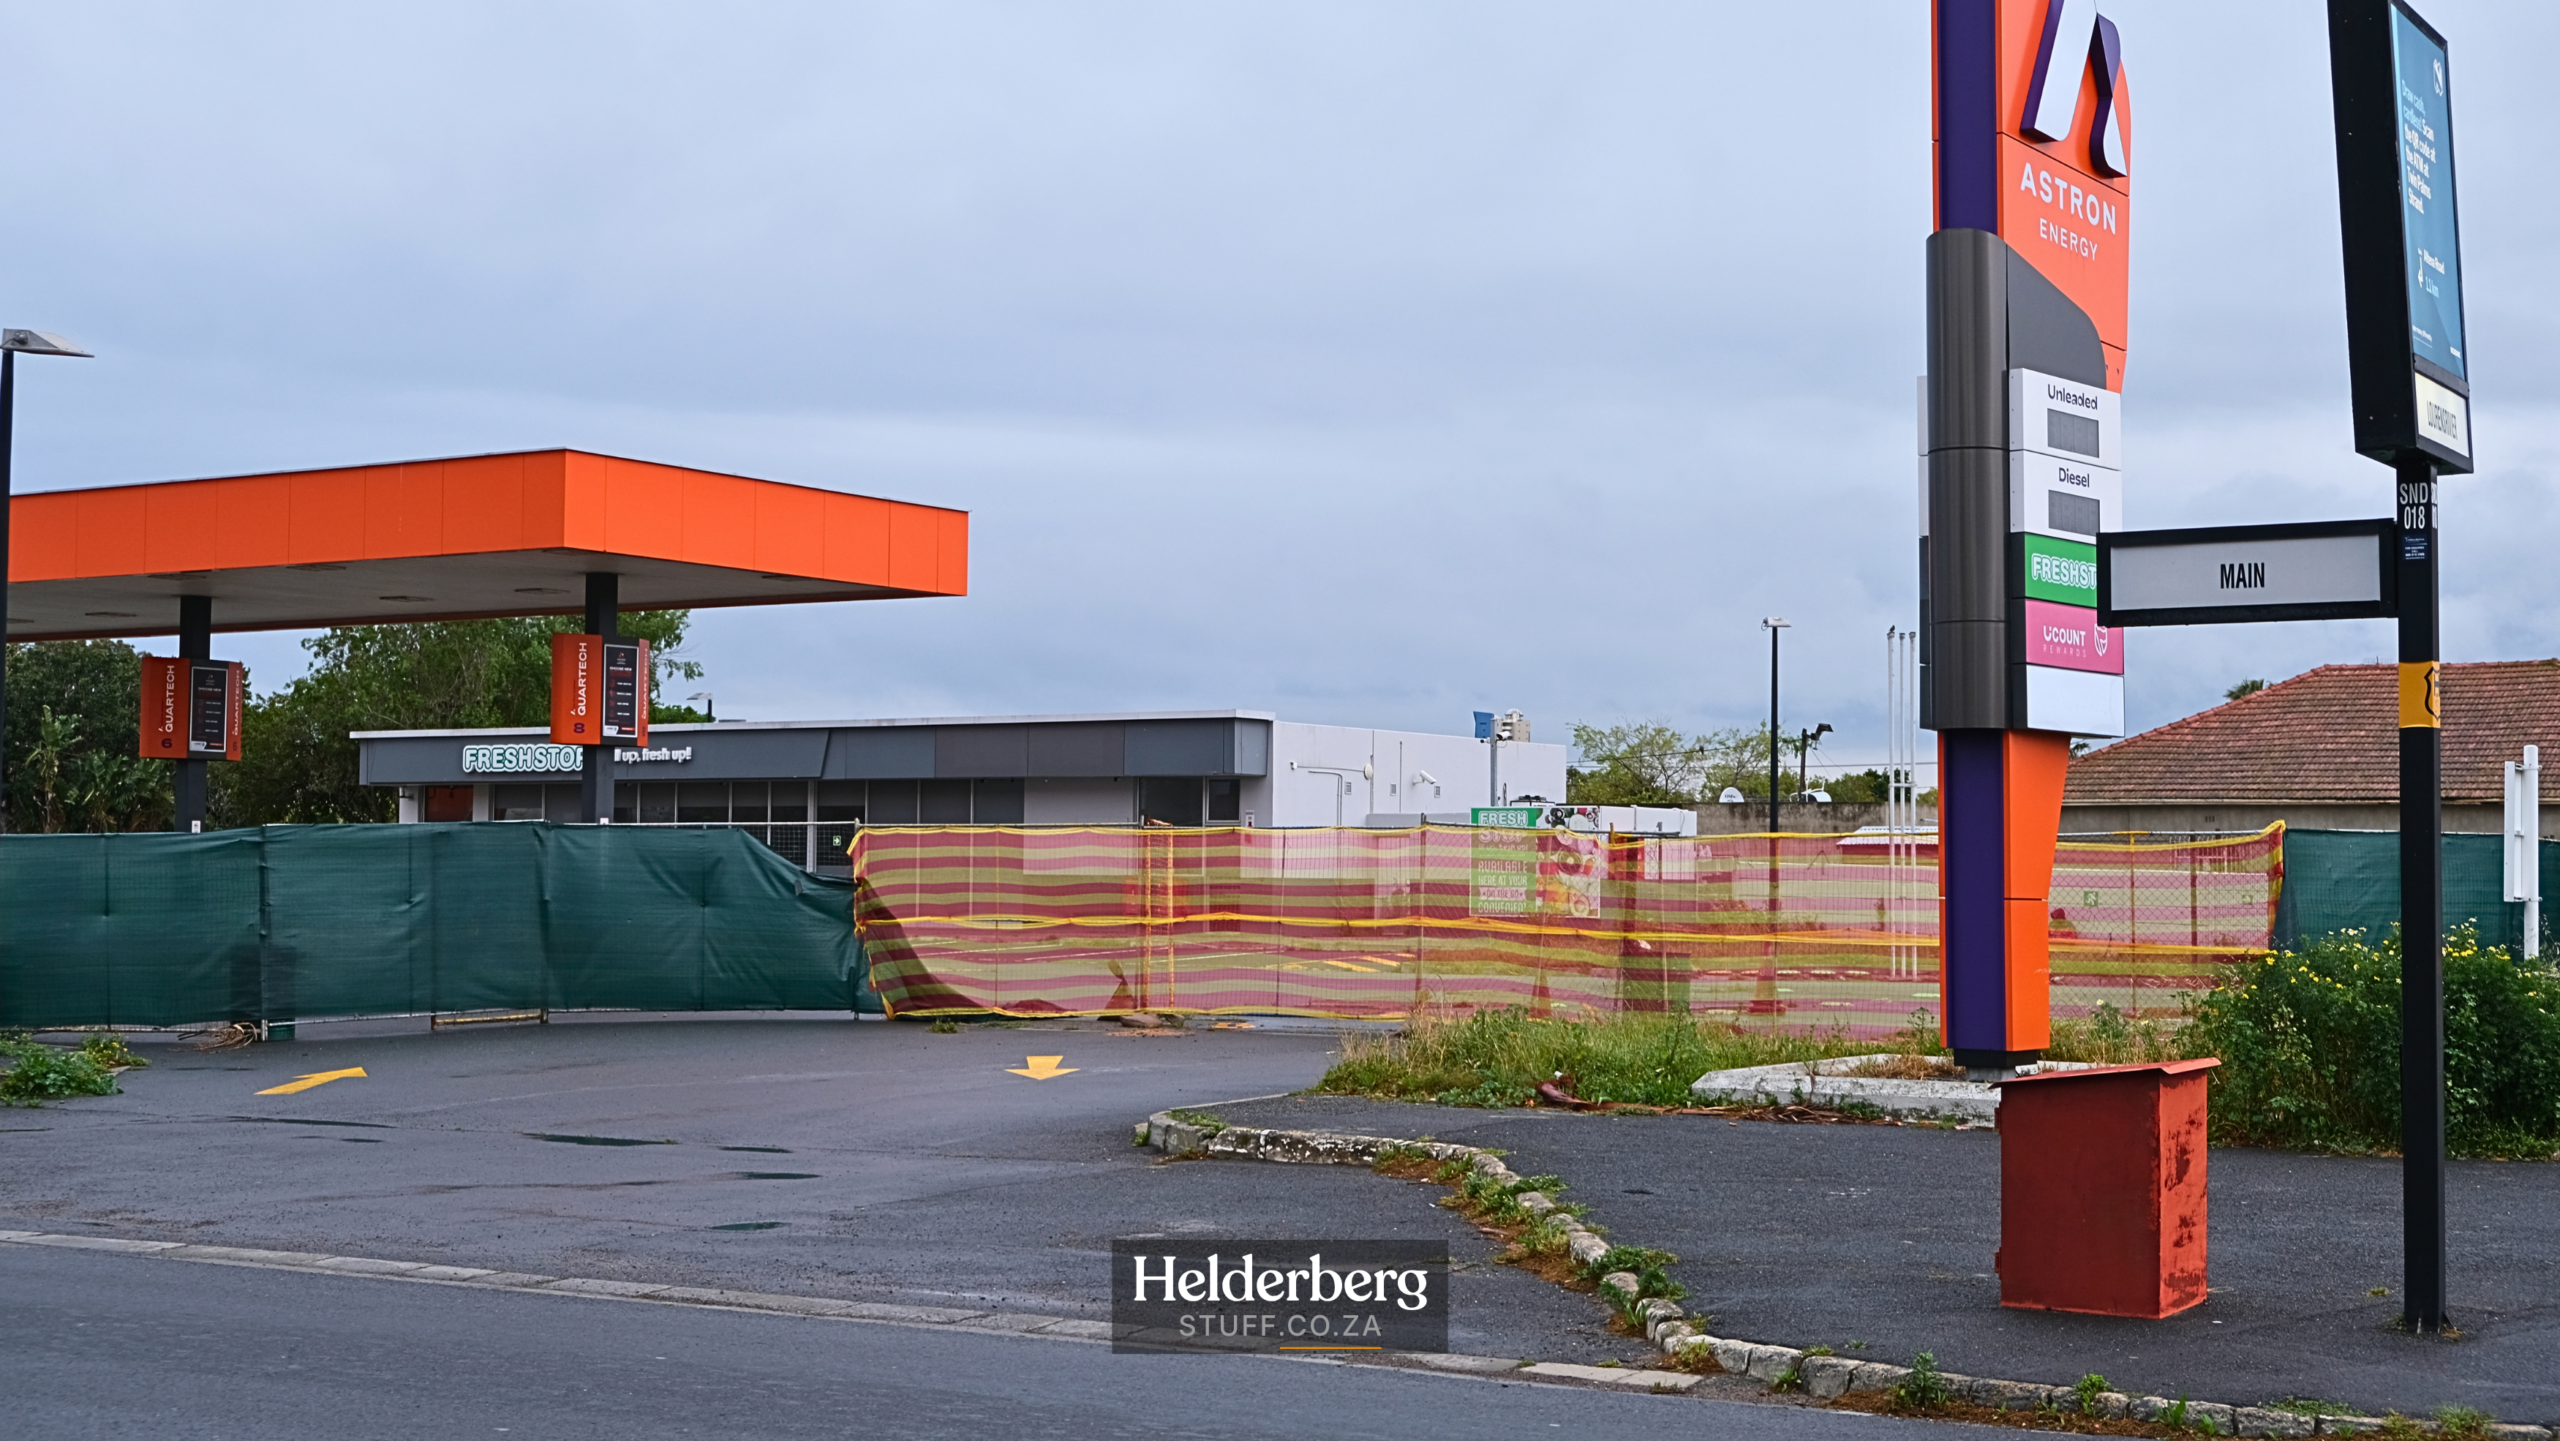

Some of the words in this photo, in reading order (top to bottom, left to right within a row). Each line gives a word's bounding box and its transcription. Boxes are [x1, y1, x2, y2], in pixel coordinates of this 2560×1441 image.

[2020, 162, 2116, 236] ASTRON
[2039, 217, 2098, 262] ENERGY
[2047, 383, 2099, 411] Unleaded
[2058, 466, 2091, 489] Diesel
[2399, 482, 2429, 505] SND
[2403, 505, 2426, 530] 018
[2031, 552, 2097, 590] FRESHST
[2220, 562, 2265, 590] MAIN
[2043, 643, 2087, 658] REWARDS
[577, 642, 588, 716] QUARTECH
[165, 664, 175, 733] QUARTECH
[573, 722, 586, 734] 8
[161, 738, 173, 749] 6
[641, 747, 671, 762] fresh
[671, 746, 692, 763] up!
[1478, 810, 1528, 828] FRESH
[1478, 860, 1528, 873] AVAILABLE
[1478, 875, 1497, 886] HERE
[1498, 875, 1507, 886] AT
[1509, 875, 1528, 886] YOUR
